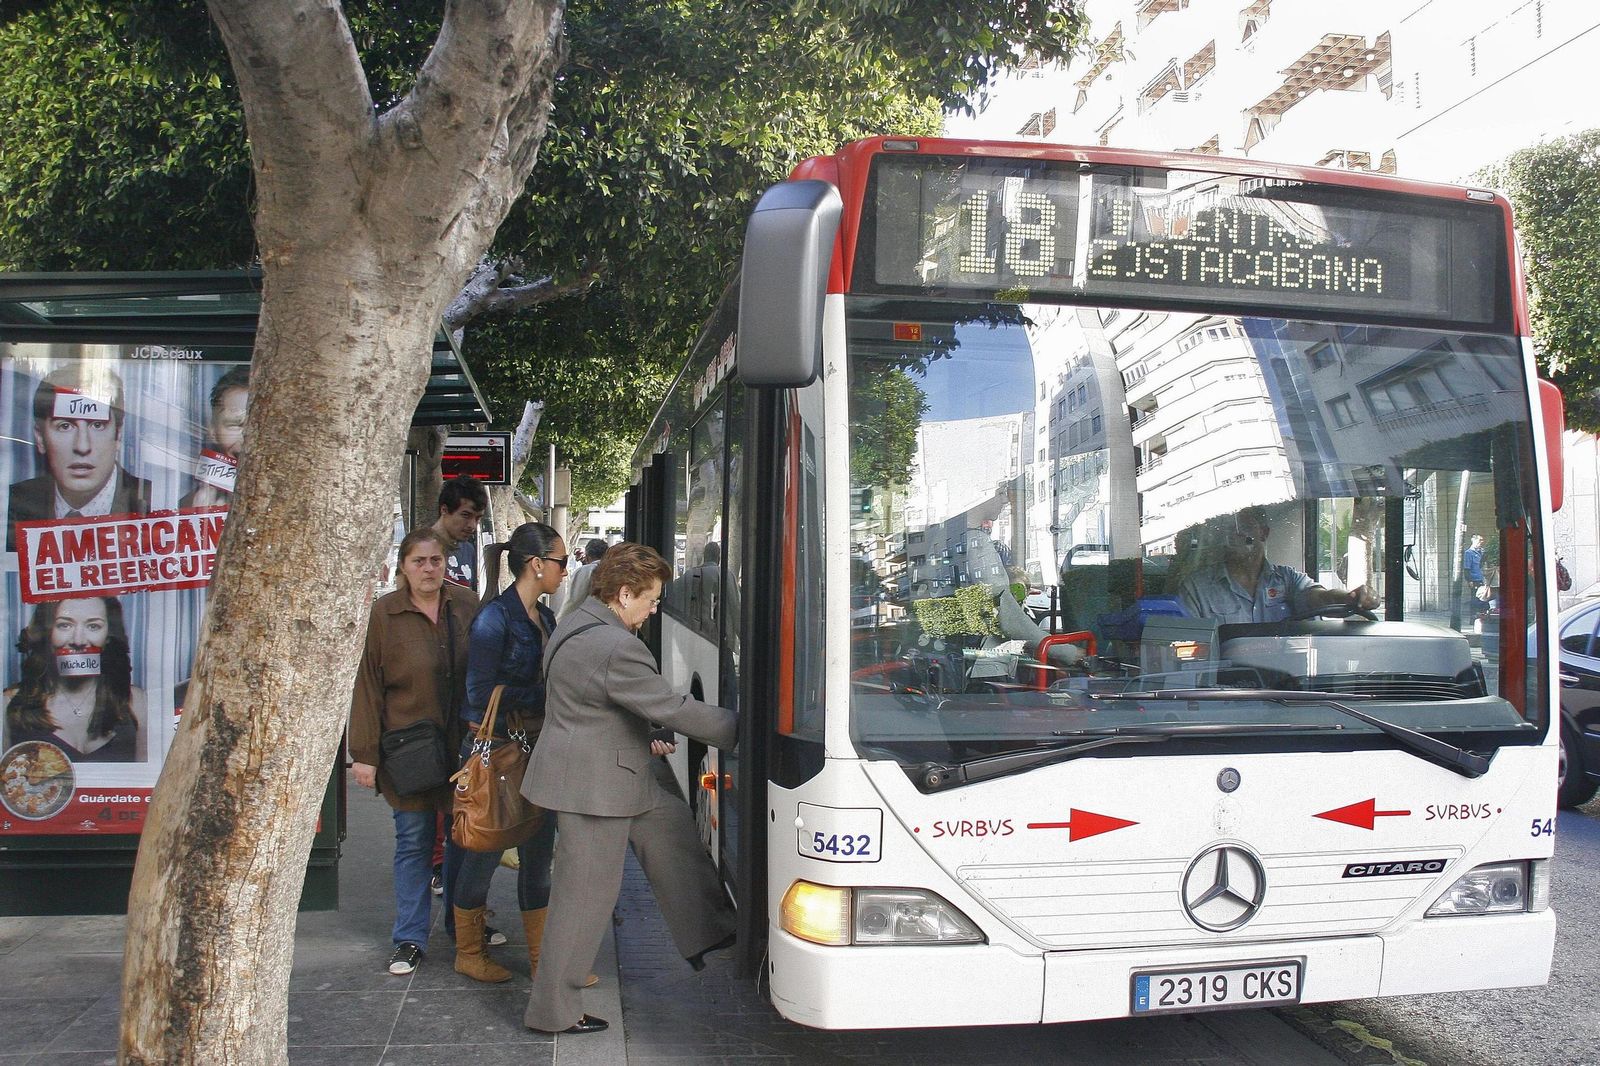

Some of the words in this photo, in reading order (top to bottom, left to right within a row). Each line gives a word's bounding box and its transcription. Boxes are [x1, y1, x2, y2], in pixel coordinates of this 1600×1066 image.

[960, 189, 1055, 276] 18
[131, 347, 203, 360] JCDecaux
[70, 398, 97, 414] Jim
[36, 516, 225, 566] AMERICAN
[37, 567, 73, 590] EL
[79, 793, 141, 804] Guárdate
[99, 806, 112, 820] 4
[813, 830, 871, 857] 5432
[1348, 861, 1442, 877] CITARO
[1158, 974, 1229, 1007] 2319
[1242, 969, 1293, 1001] CKS
[1139, 996, 1147, 1005] E
